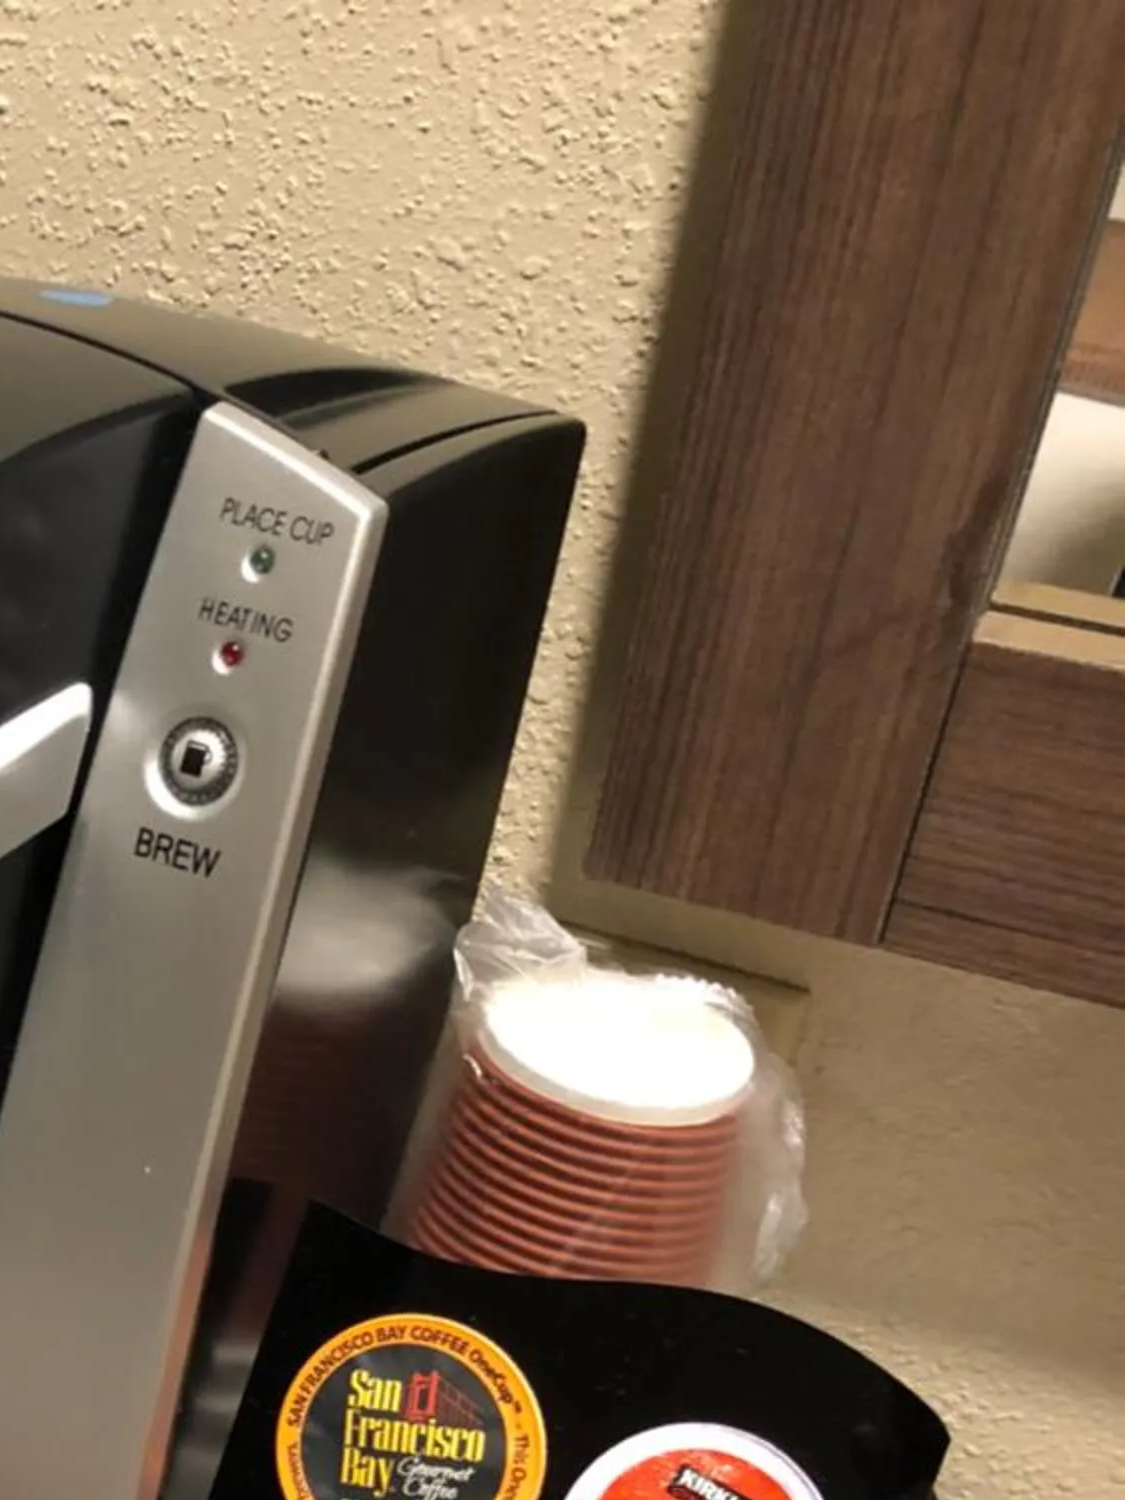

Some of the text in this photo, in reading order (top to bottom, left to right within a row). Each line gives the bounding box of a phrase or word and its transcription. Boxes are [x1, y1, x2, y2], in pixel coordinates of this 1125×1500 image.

[219, 497, 335, 545] PLACE CUP
[198, 597, 293, 642] HEATING
[133, 826, 222, 878] BREW
[287, 1391, 308, 1426] SAN
[303, 1330, 374, 1391] FRANCISCO
[374, 1324, 405, 1342] BAY
[410, 1325, 469, 1354] COFFEE
[348, 1369, 402, 1413] San
[344, 1408, 486, 1463] Francisco
[340, 1447, 393, 1497] Bay
[397, 1455, 477, 1482] Gourmet
